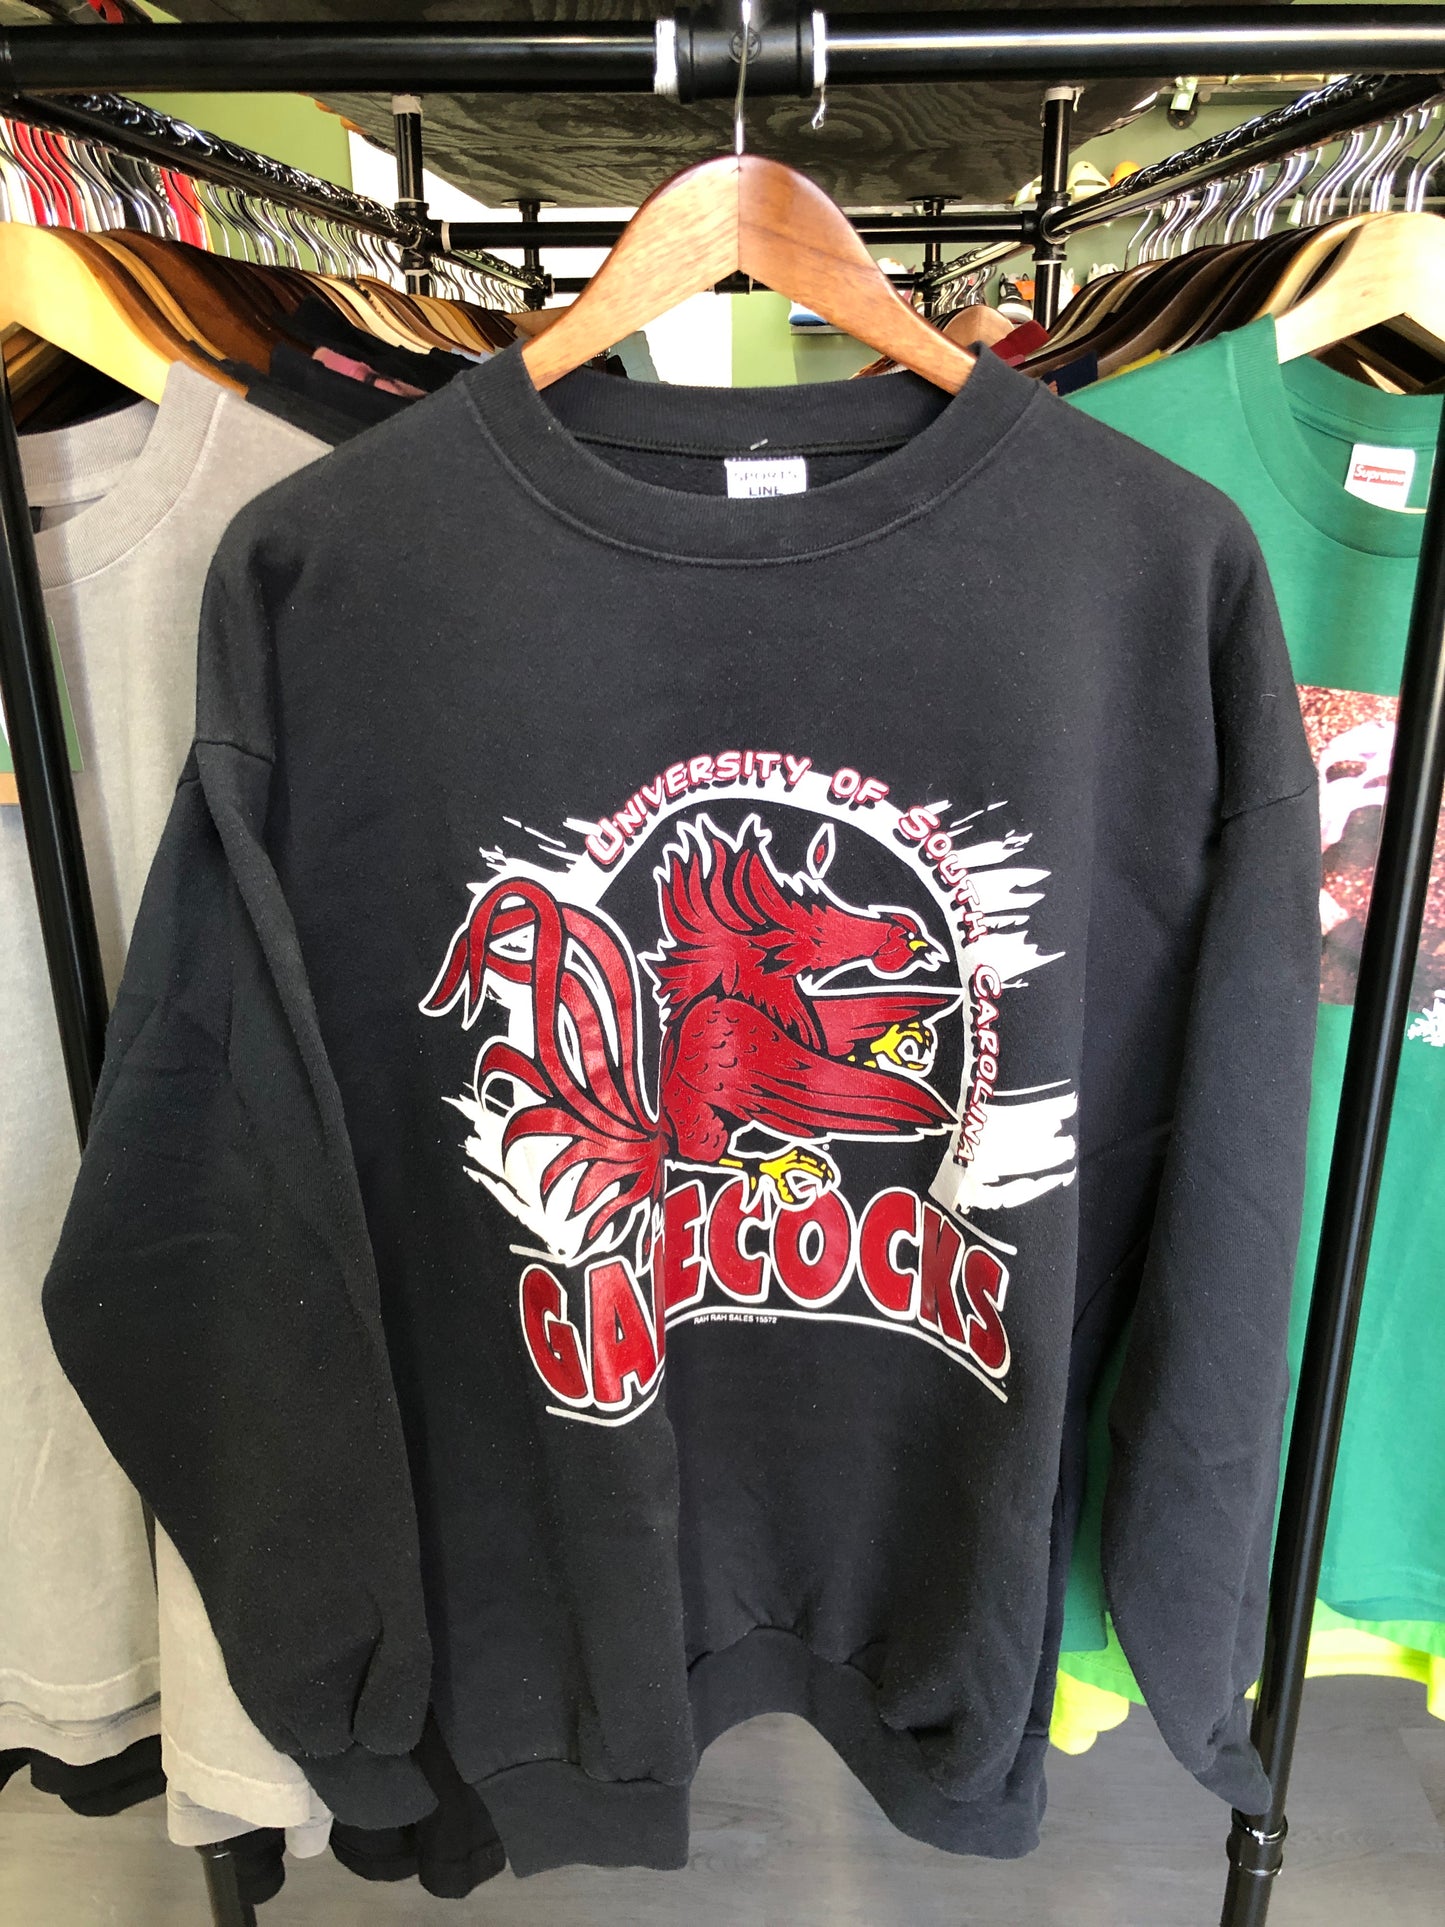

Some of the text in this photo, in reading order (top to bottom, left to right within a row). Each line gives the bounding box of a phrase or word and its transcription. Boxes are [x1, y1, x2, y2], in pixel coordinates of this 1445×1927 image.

[748, 485, 783, 497] LINE
[584, 749, 1003, 1169] UNIVERSITY OF SOUTH CAROLINA
[519, 1177, 1011, 1411] GAECOCKS
[693, 1314, 709, 1325] RAH
[710, 1313, 727, 1321] RAH
[728, 1313, 754, 1323] SALES
